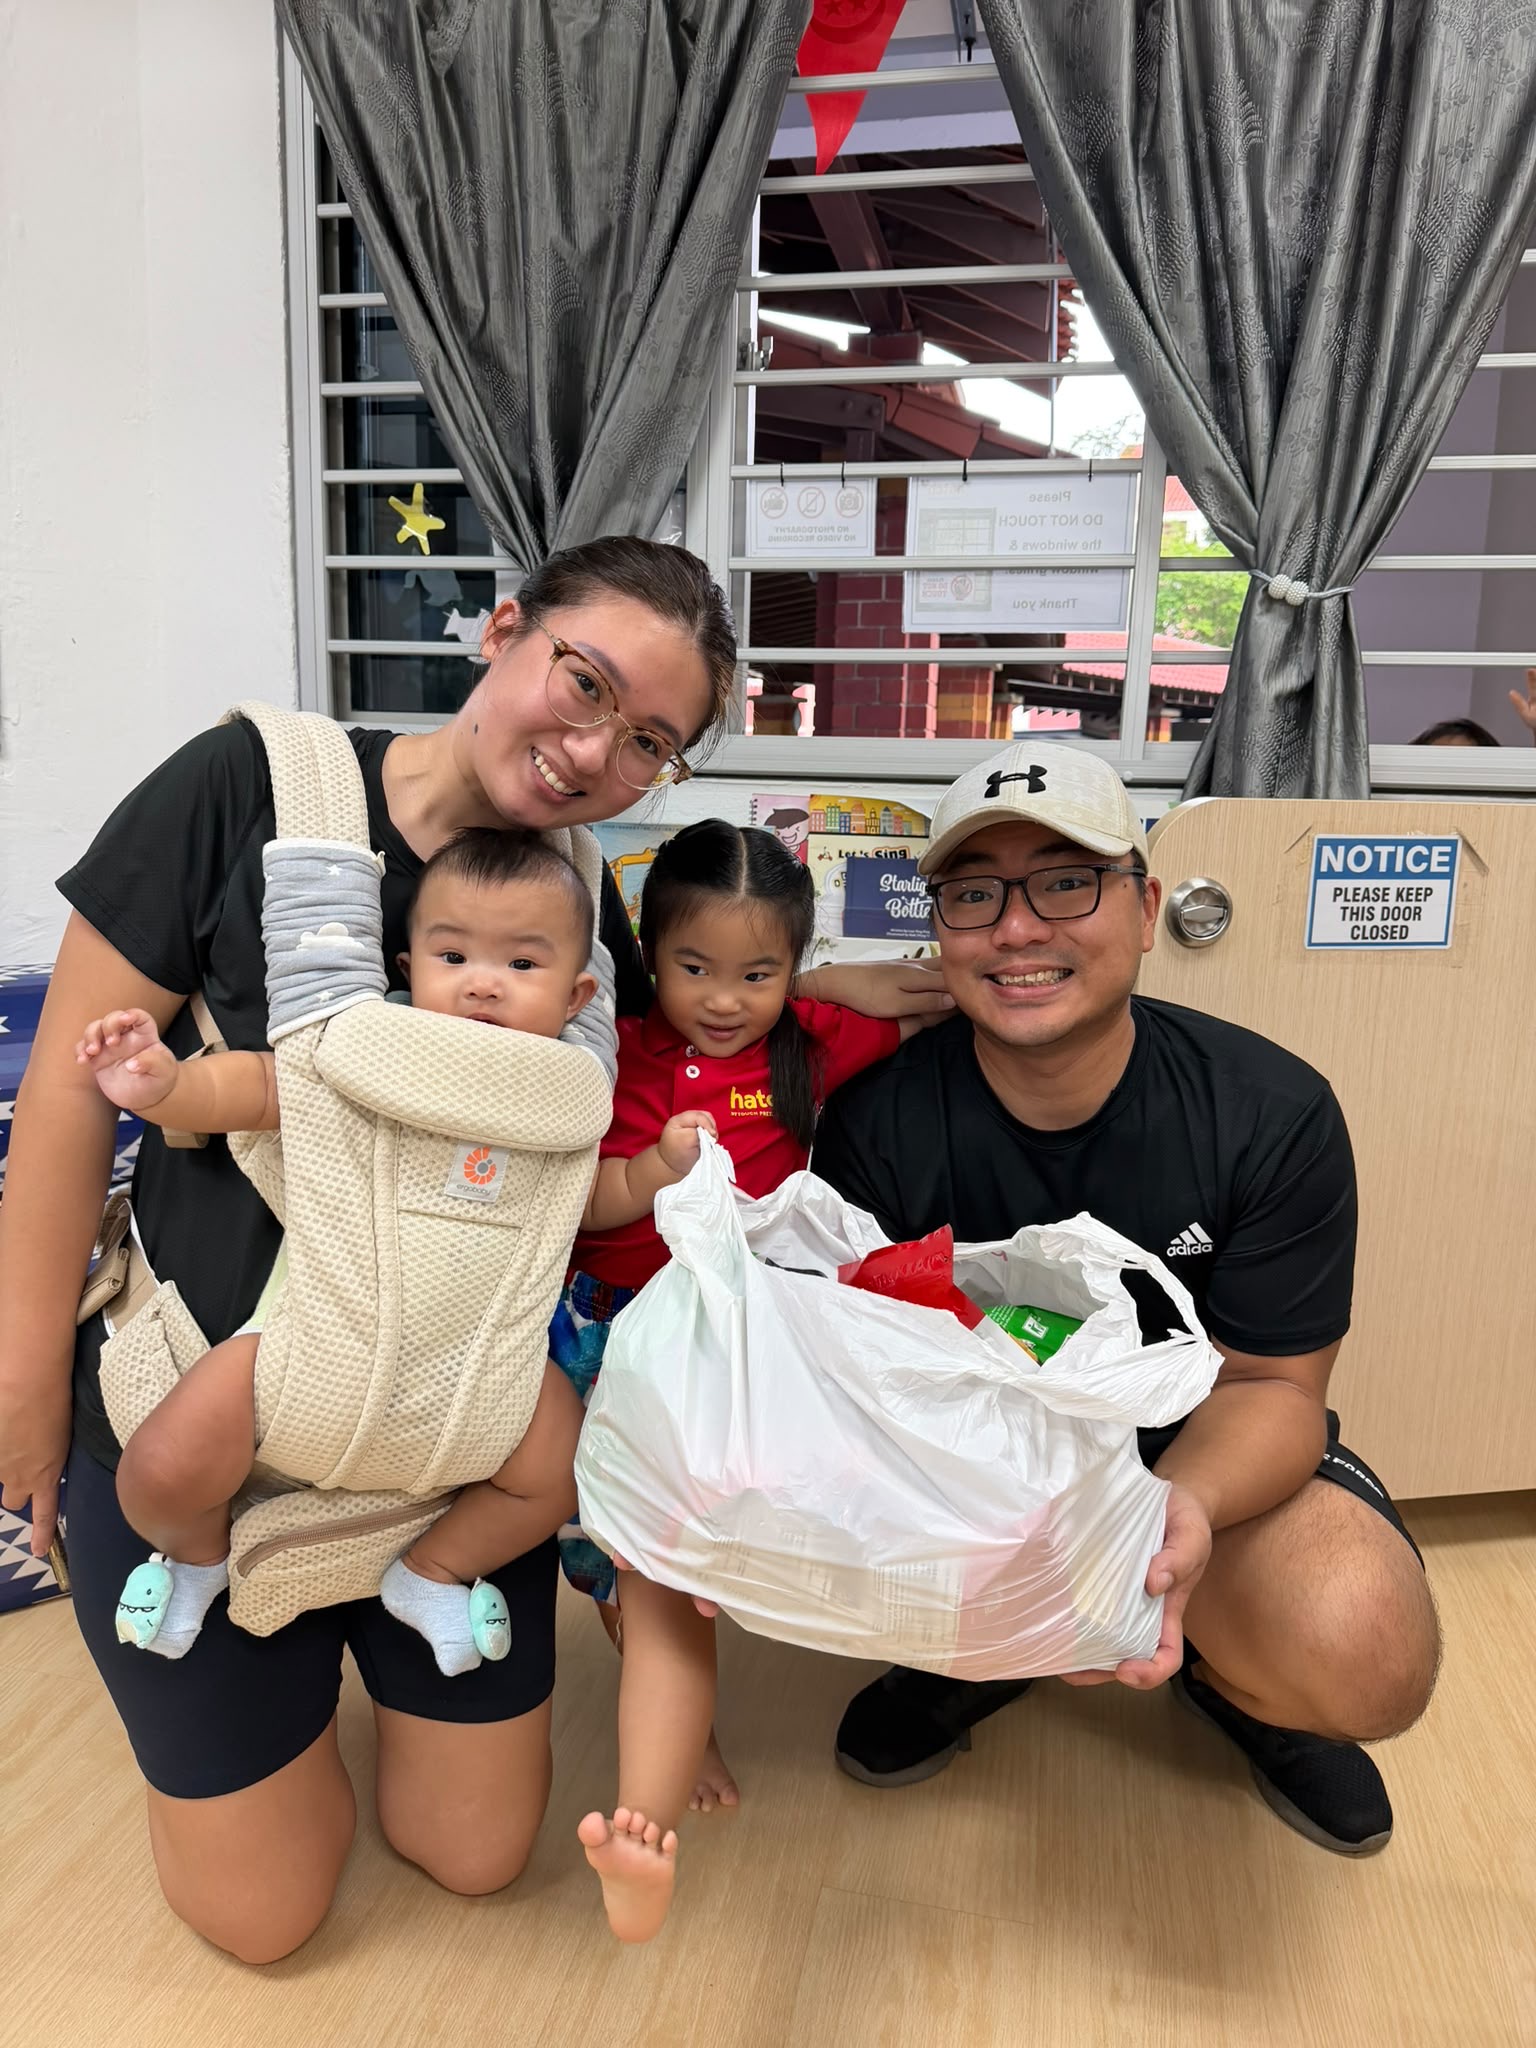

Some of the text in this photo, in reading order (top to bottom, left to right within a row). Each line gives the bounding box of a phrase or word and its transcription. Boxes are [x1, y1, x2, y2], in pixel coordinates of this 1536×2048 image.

[1320, 844, 1452, 873] NOTICE
[879, 873, 928, 897] Starlig
[1332, 886, 1434, 903] PLEASE KEEP
[1340, 905, 1422, 922] THIS DOOR
[1350, 925, 1409, 941] CLOSED
[730, 1086, 774, 1110] hatc
[456, 1184, 491, 1197] ergobaby
[1166, 1243, 1213, 1257] adida
